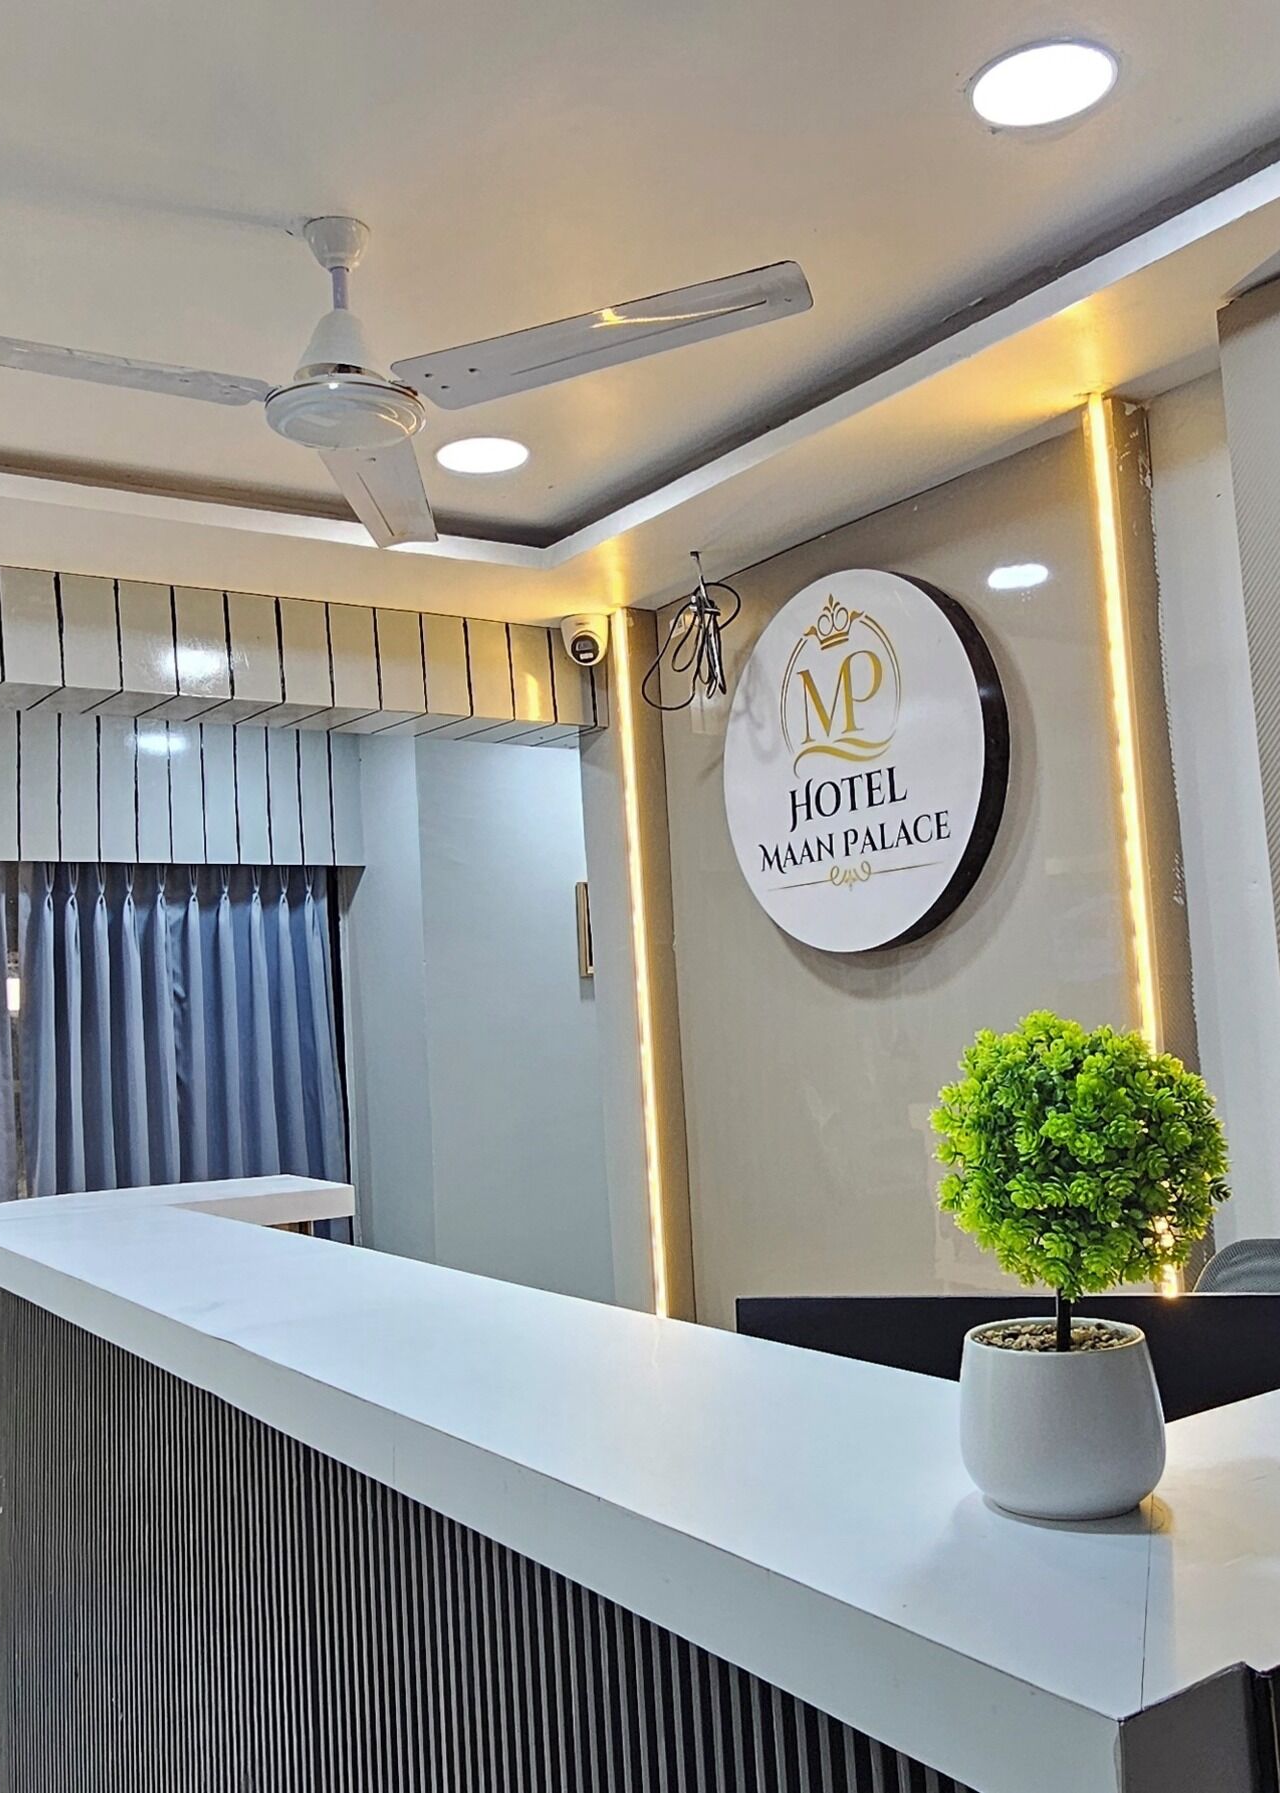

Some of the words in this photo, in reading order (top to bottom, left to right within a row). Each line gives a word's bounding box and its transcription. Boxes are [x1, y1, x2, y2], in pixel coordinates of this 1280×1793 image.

[796, 650, 883, 744] MP
[788, 766, 908, 833] HOTEL
[758, 832, 835, 877] MAAN
[843, 810, 951, 858] PALACE
